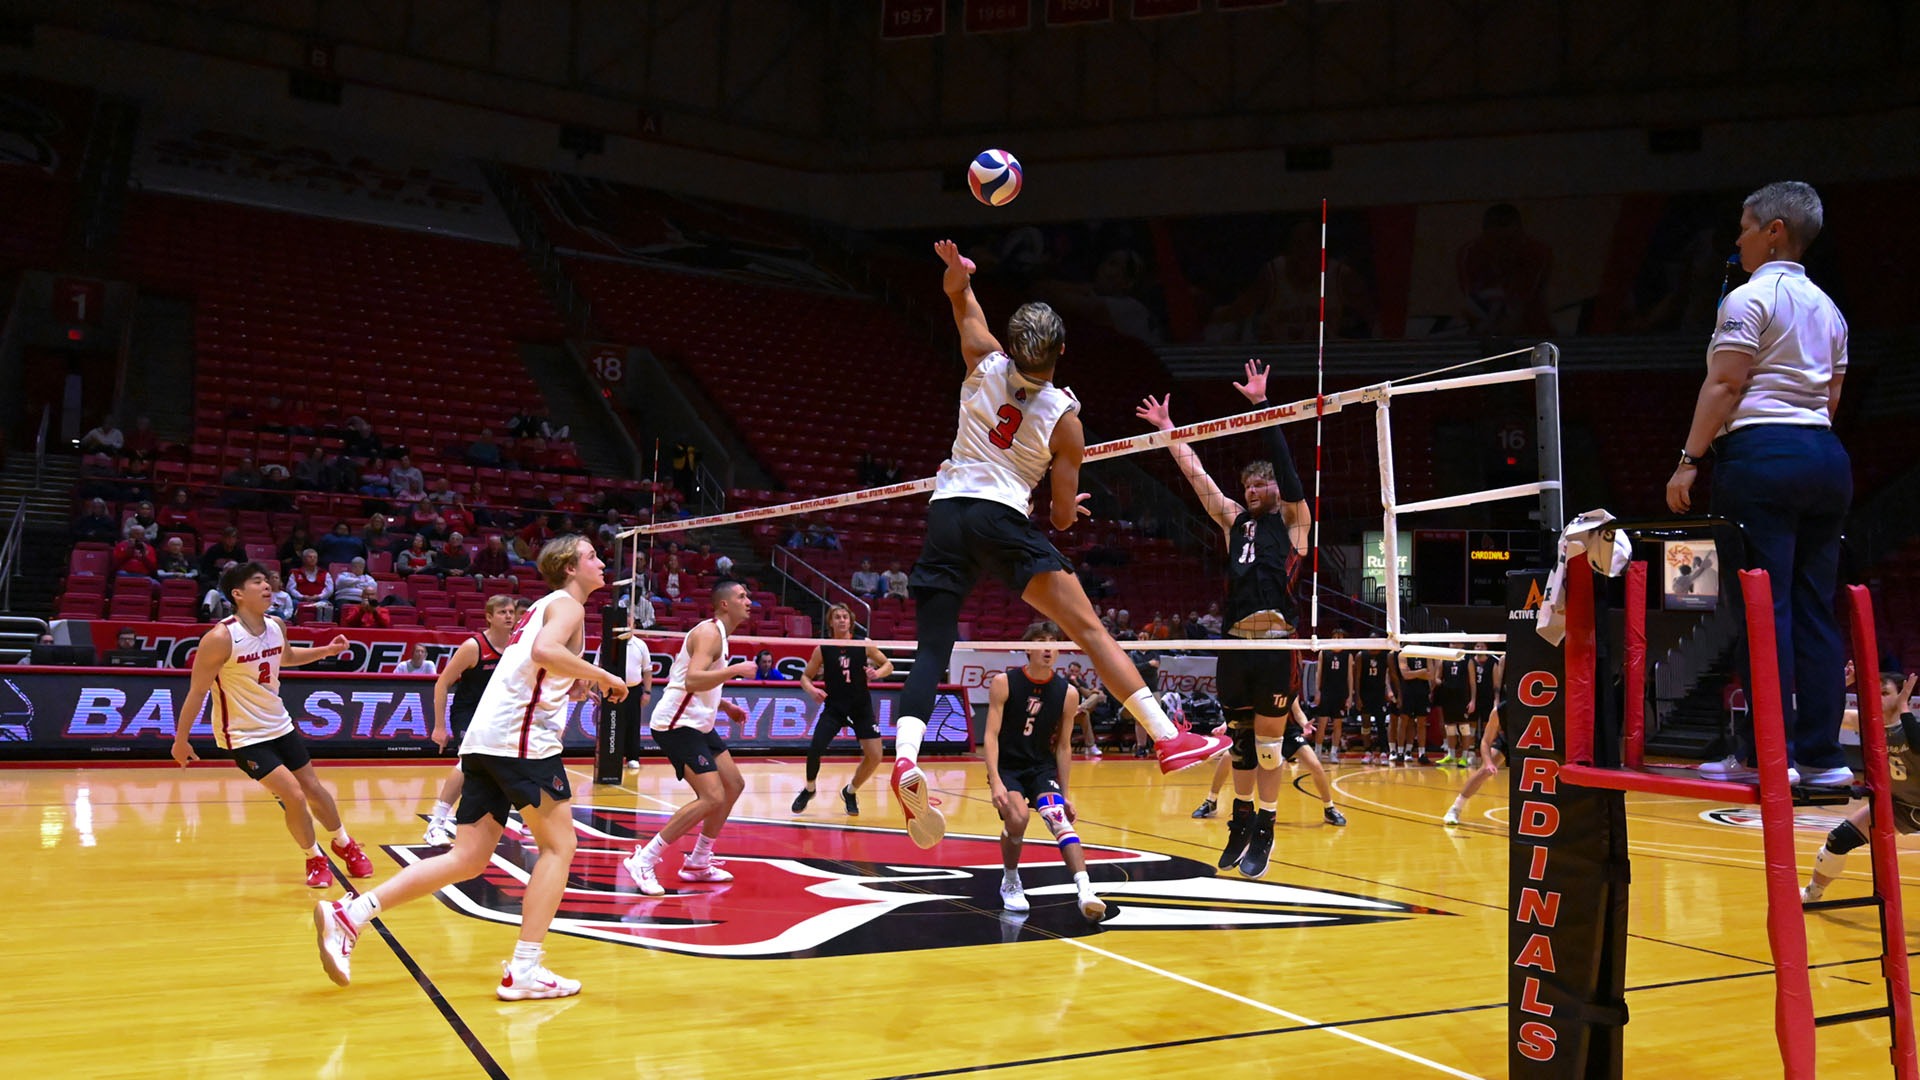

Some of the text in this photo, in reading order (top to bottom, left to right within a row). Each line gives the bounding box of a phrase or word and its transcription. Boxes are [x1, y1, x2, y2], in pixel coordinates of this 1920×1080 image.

[892, 9, 935, 25] 1957
[593, 356, 622, 381] 18
[989, 403, 1023, 449] 3
[1171, 406, 1296, 440] BALL STATE VOLLEYBALL
[1497, 430, 1525, 448] 16
[1084, 440, 1133, 457] VOLLEYBALL
[1367, 555, 1408, 568] Ruff
[1470, 550, 1511, 560] CARDINALS
[1508, 610, 1535, 620] ACTIVE
[237, 646, 282, 664] BALL STATE
[258, 661, 270, 684] 2
[842, 669, 851, 683] 7
[1026, 695, 1043, 715] TU
[1273, 694, 1287, 708] TU
[1023, 716, 1035, 736] 5
[1888, 756, 1908, 781] 6
[1514, 672, 1560, 1062] CARDINALS
